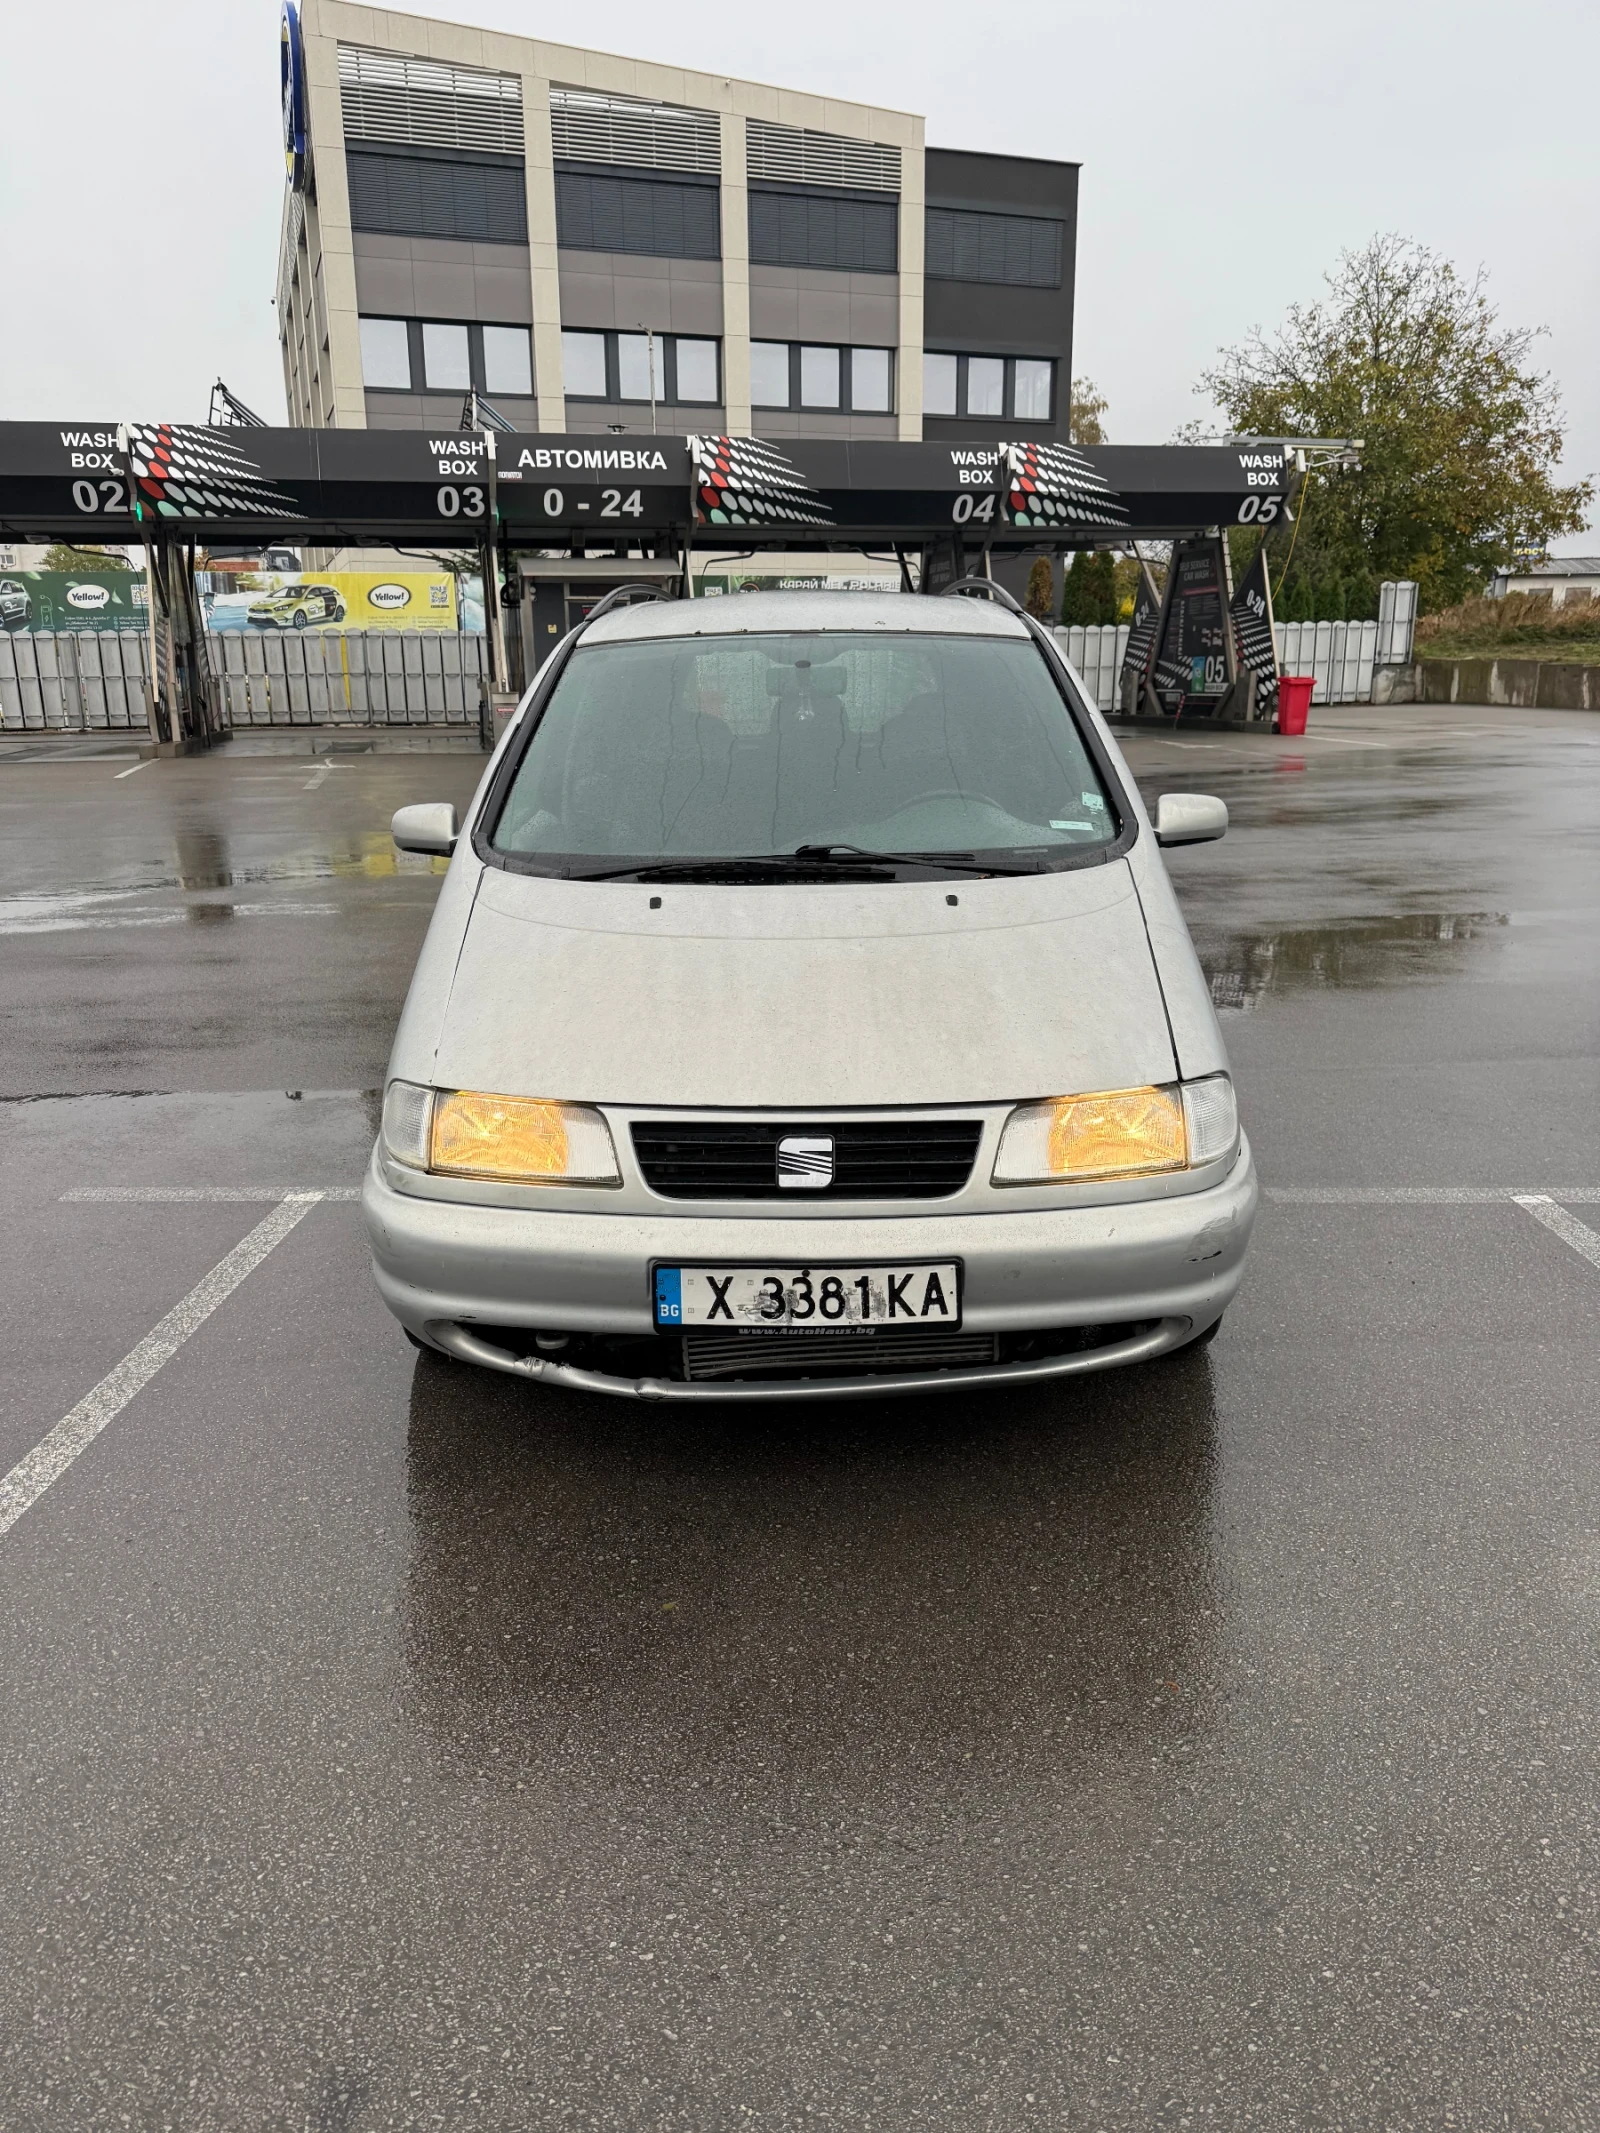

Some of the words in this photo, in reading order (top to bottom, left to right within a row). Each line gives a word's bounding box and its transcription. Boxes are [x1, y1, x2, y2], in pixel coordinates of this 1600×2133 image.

[60, 432, 119, 448] WASH
[429, 440, 484, 456] WASH
[71, 452, 114, 469] BOX
[518, 448, 668, 470] АВТОМИВКА
[951, 450, 999, 465] WASH
[1239, 454, 1283, 468] WASH
[439, 460, 478, 475] BOX
[959, 469, 994, 484] BOX
[1247, 473, 1279, 487] BOX
[73, 481, 128, 513] 02
[437, 486, 485, 518] 03
[600, 489, 644, 518] 24
[952, 494, 996, 523] 04
[1237, 495, 1282, 524] 05
[780, 578, 818, 589] КАРАЙ
[72, 592, 105, 601] Yellow!
[375, 592, 405, 601] Yellow!
[1246, 589, 1266, 618] 0-24
[1205, 655, 1225, 683] 05
[660, 1304, 679, 1316] BG
